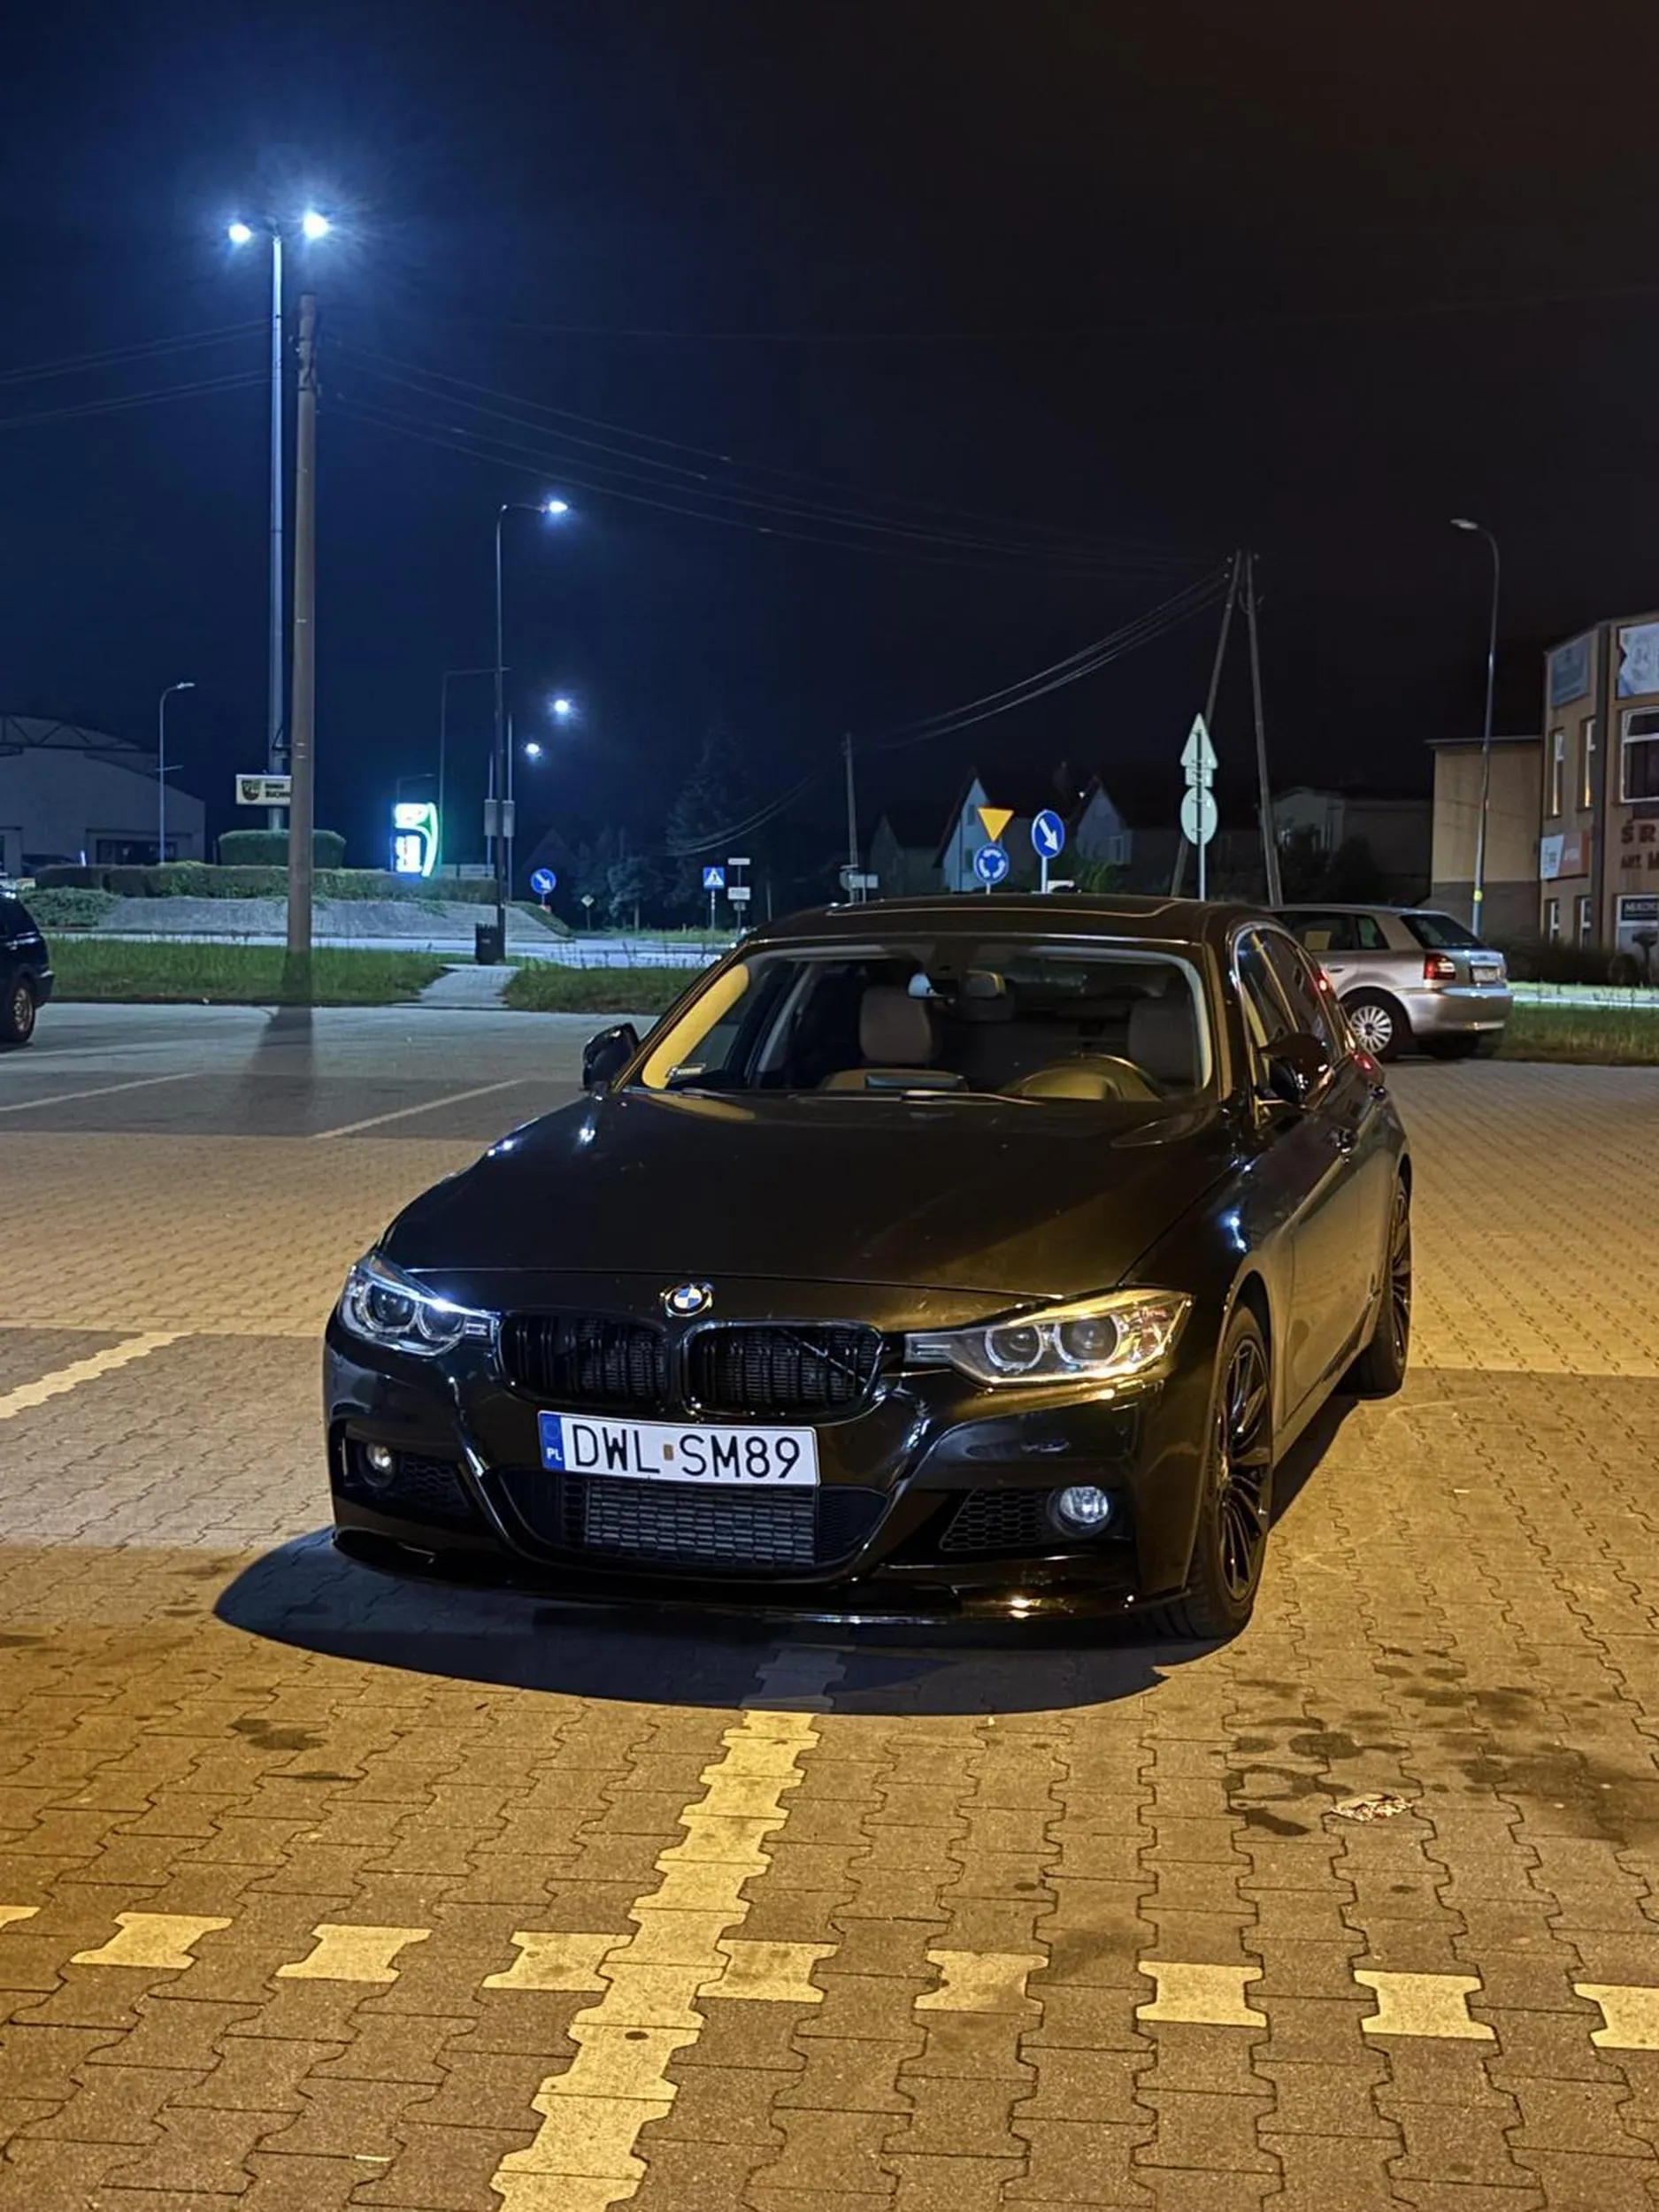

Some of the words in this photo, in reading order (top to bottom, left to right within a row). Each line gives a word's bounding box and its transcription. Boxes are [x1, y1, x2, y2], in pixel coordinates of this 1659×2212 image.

[546, 1447, 563, 1461] PL
[572, 1424, 661, 1474] DWL
[679, 1433, 801, 1479] SM89
